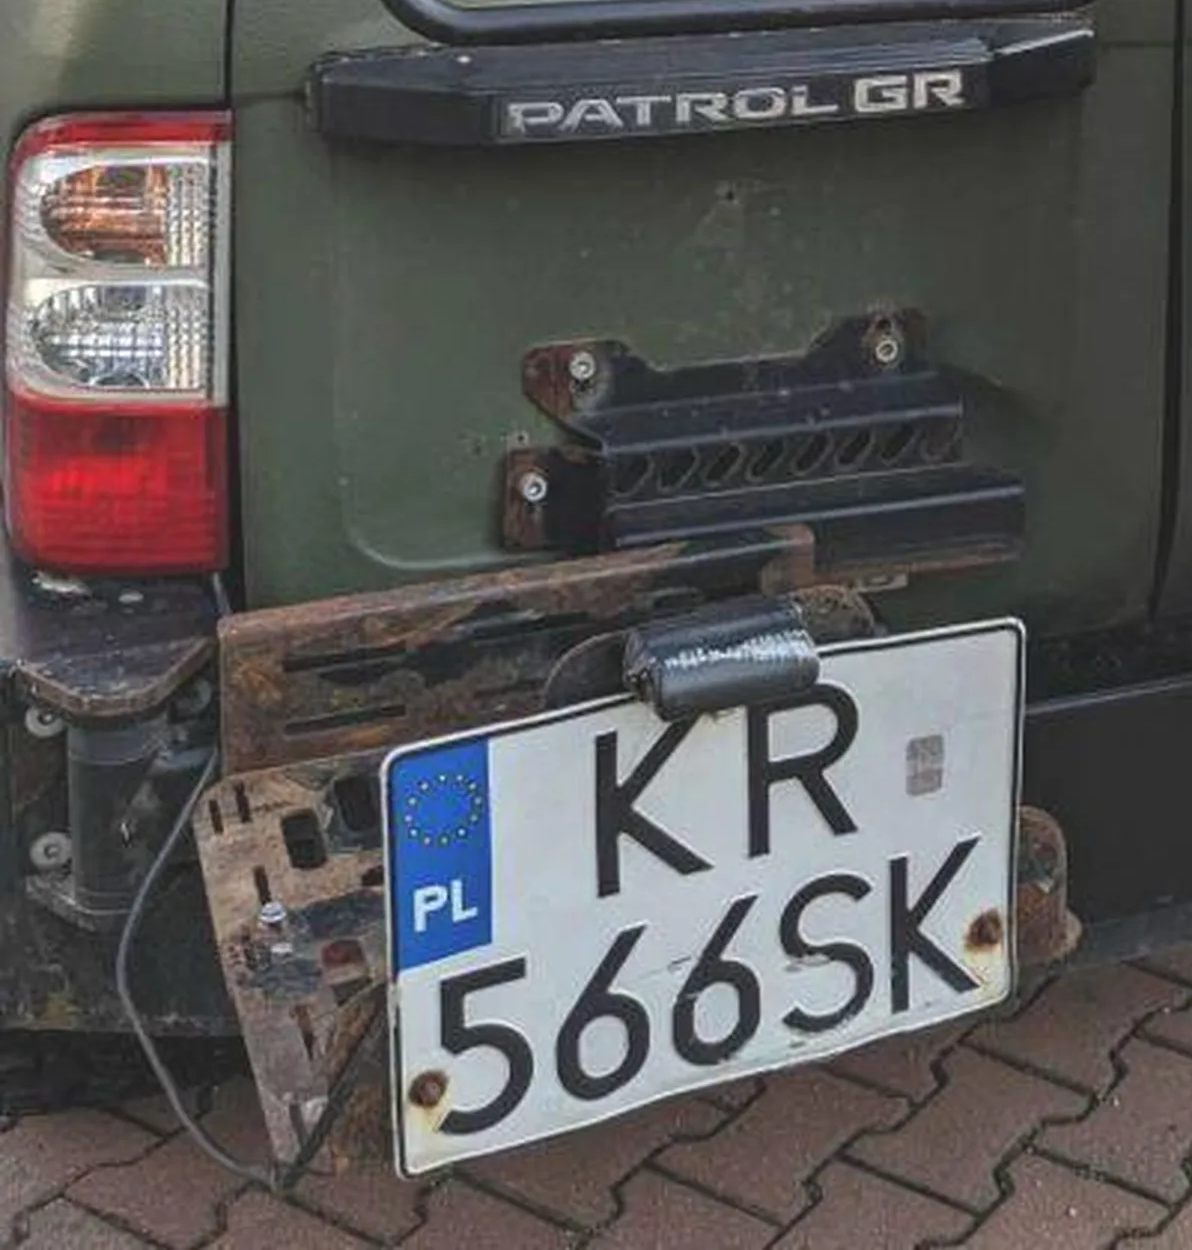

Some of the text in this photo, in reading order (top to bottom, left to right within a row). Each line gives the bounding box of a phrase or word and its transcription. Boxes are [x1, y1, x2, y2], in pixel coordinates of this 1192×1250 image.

[505, 67, 965, 133] PATROL GR
[594, 681, 859, 899] KR
[412, 877, 479, 932] PL
[434, 835, 983, 1137] 566SK
